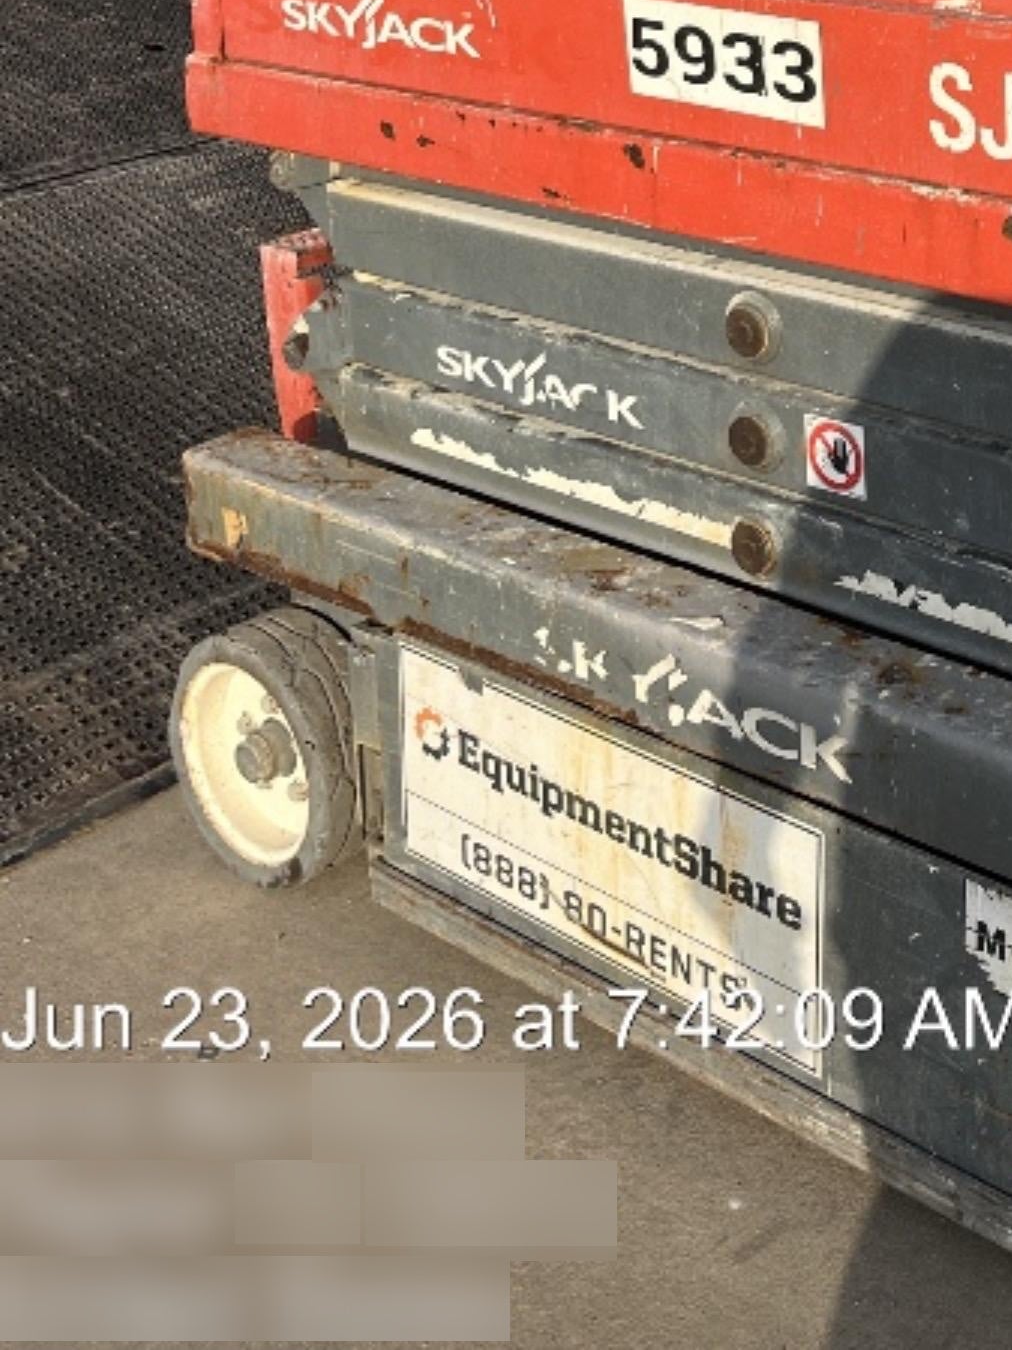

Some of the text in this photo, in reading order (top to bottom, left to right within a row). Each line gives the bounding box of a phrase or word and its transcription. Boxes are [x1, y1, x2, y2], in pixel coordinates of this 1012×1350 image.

[631, 17, 818, 104] 5933
[456, 728, 802, 931] EquipmentShare
[460, 833, 550, 910] (888)
